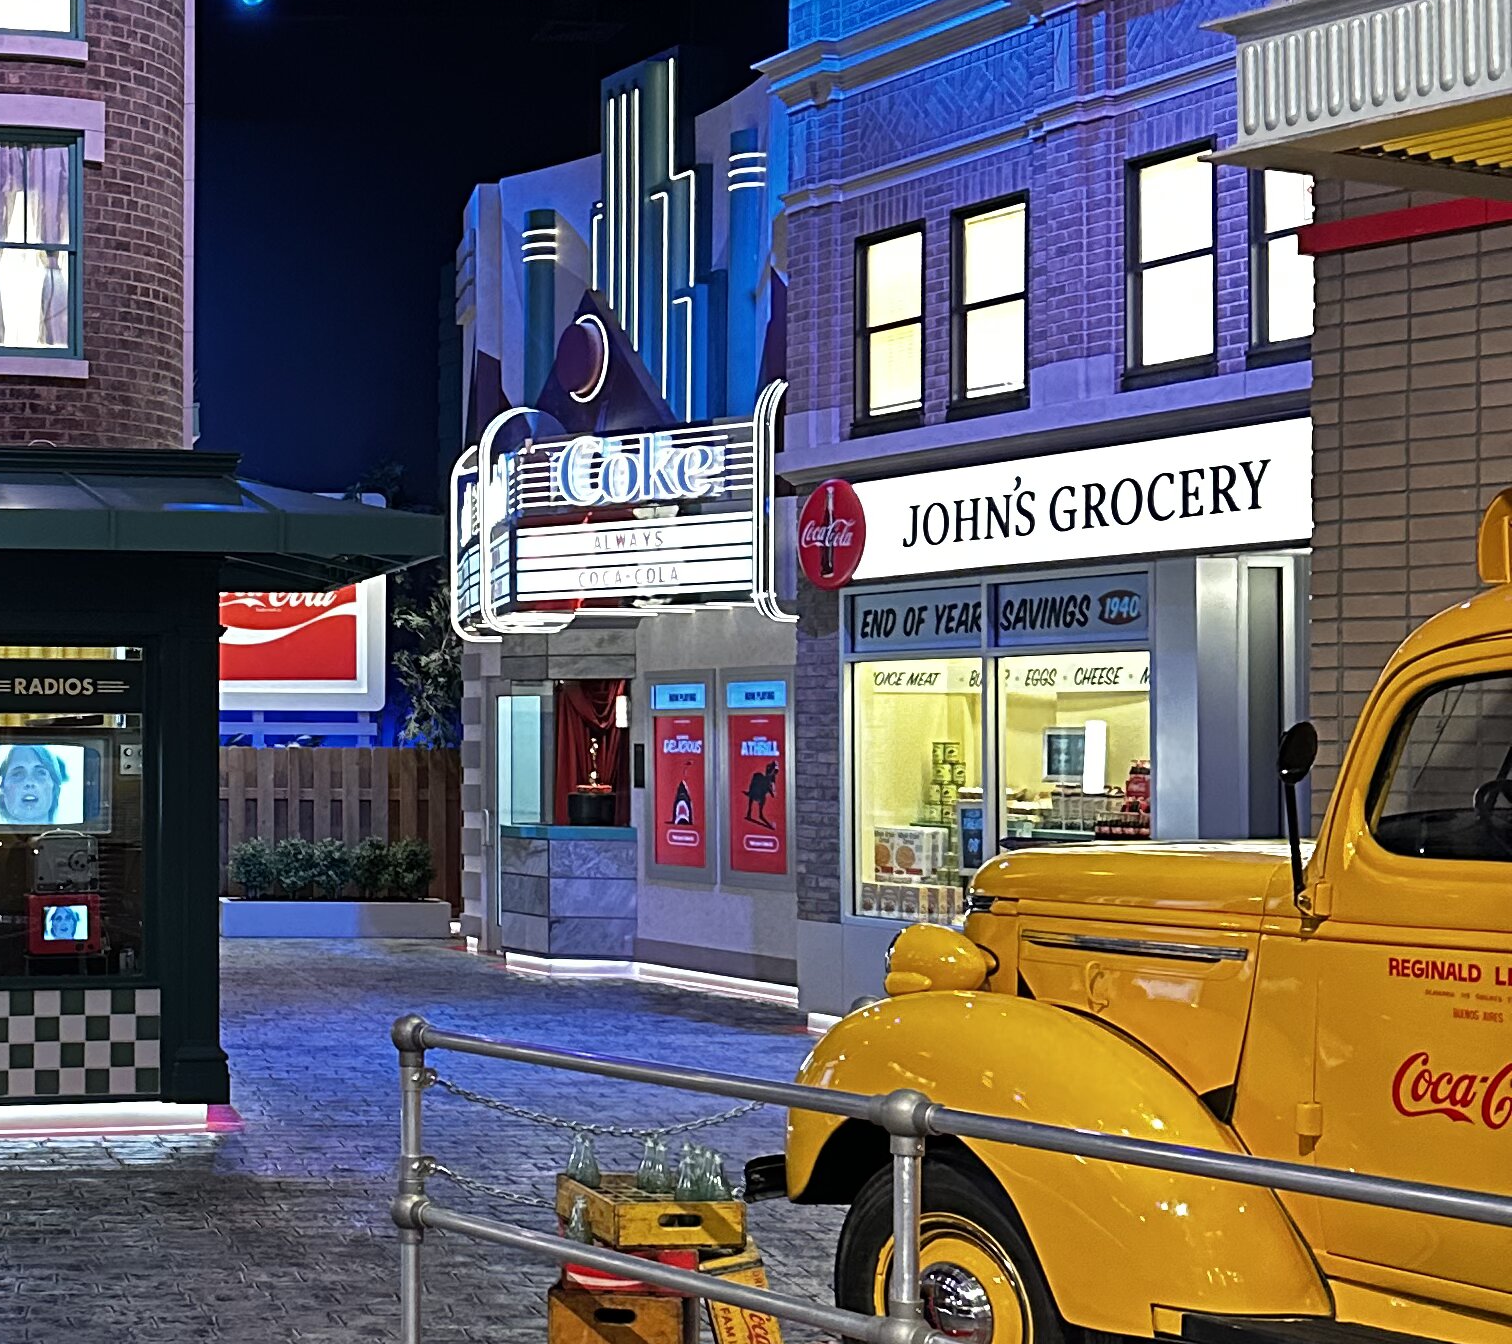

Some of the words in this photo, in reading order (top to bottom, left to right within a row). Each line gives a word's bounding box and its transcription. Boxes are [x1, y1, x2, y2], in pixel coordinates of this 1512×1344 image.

[554, 432, 718, 507] Coke
[902, 475, 1036, 548] JOHN'S
[1049, 458, 1272, 533] GROCERY
[594, 530, 664, 550] ALWAYS
[578, 566, 679, 588] COCA-COLA
[860, 609, 896, 640] END
[902, 606, 928, 636] OF
[934, 600, 982, 635] YEAR
[999, 594, 1092, 632] SAVINGS
[1104, 595, 1139, 618] 1940
[13, 677, 95, 696] RADIOS
[906, 672, 942, 686] MEAT
[1024, 668, 1058, 687] EGGS
[1073, 666, 1124, 686] CHEESE
[1388, 957, 1482, 984] REGINALD
[1392, 1051, 1512, 1130] Coca-C
